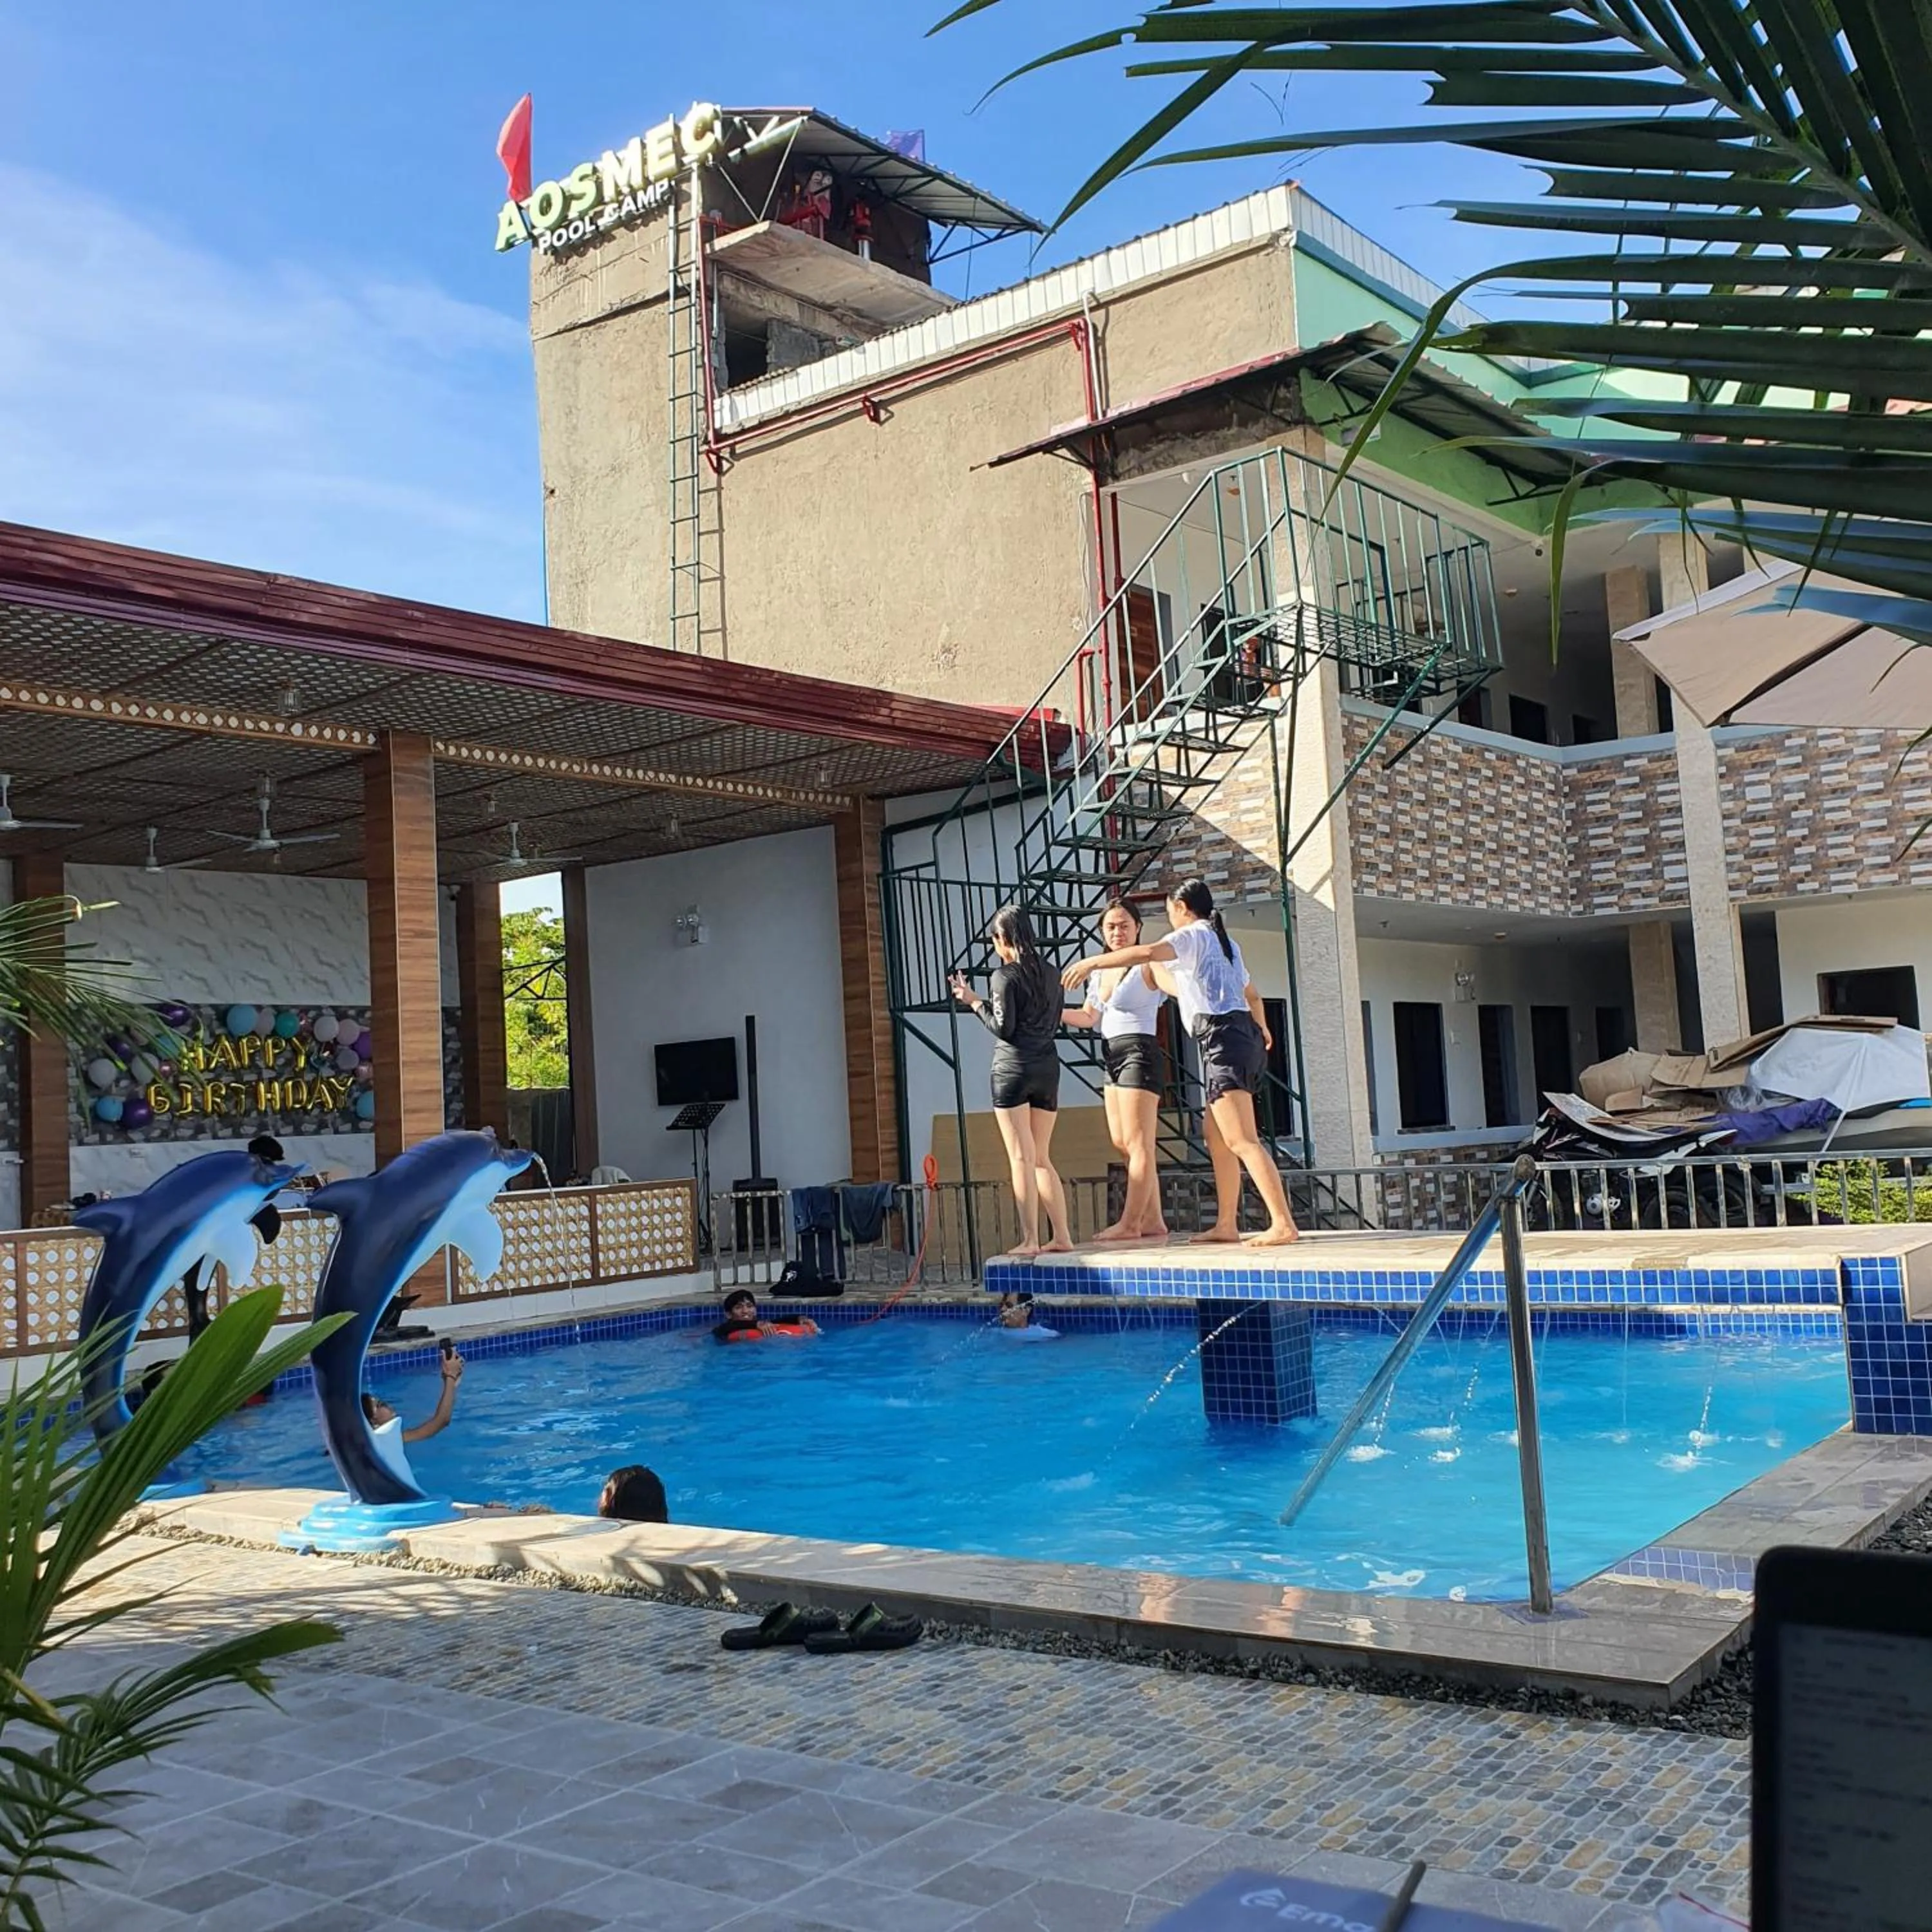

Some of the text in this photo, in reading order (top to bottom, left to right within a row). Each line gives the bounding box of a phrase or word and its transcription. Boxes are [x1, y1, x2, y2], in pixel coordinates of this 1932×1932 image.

[537, 215, 596, 254] POOL
[178, 1035, 310, 1072] HAPPY
[146, 1077, 354, 1116] BIRTHDAY
